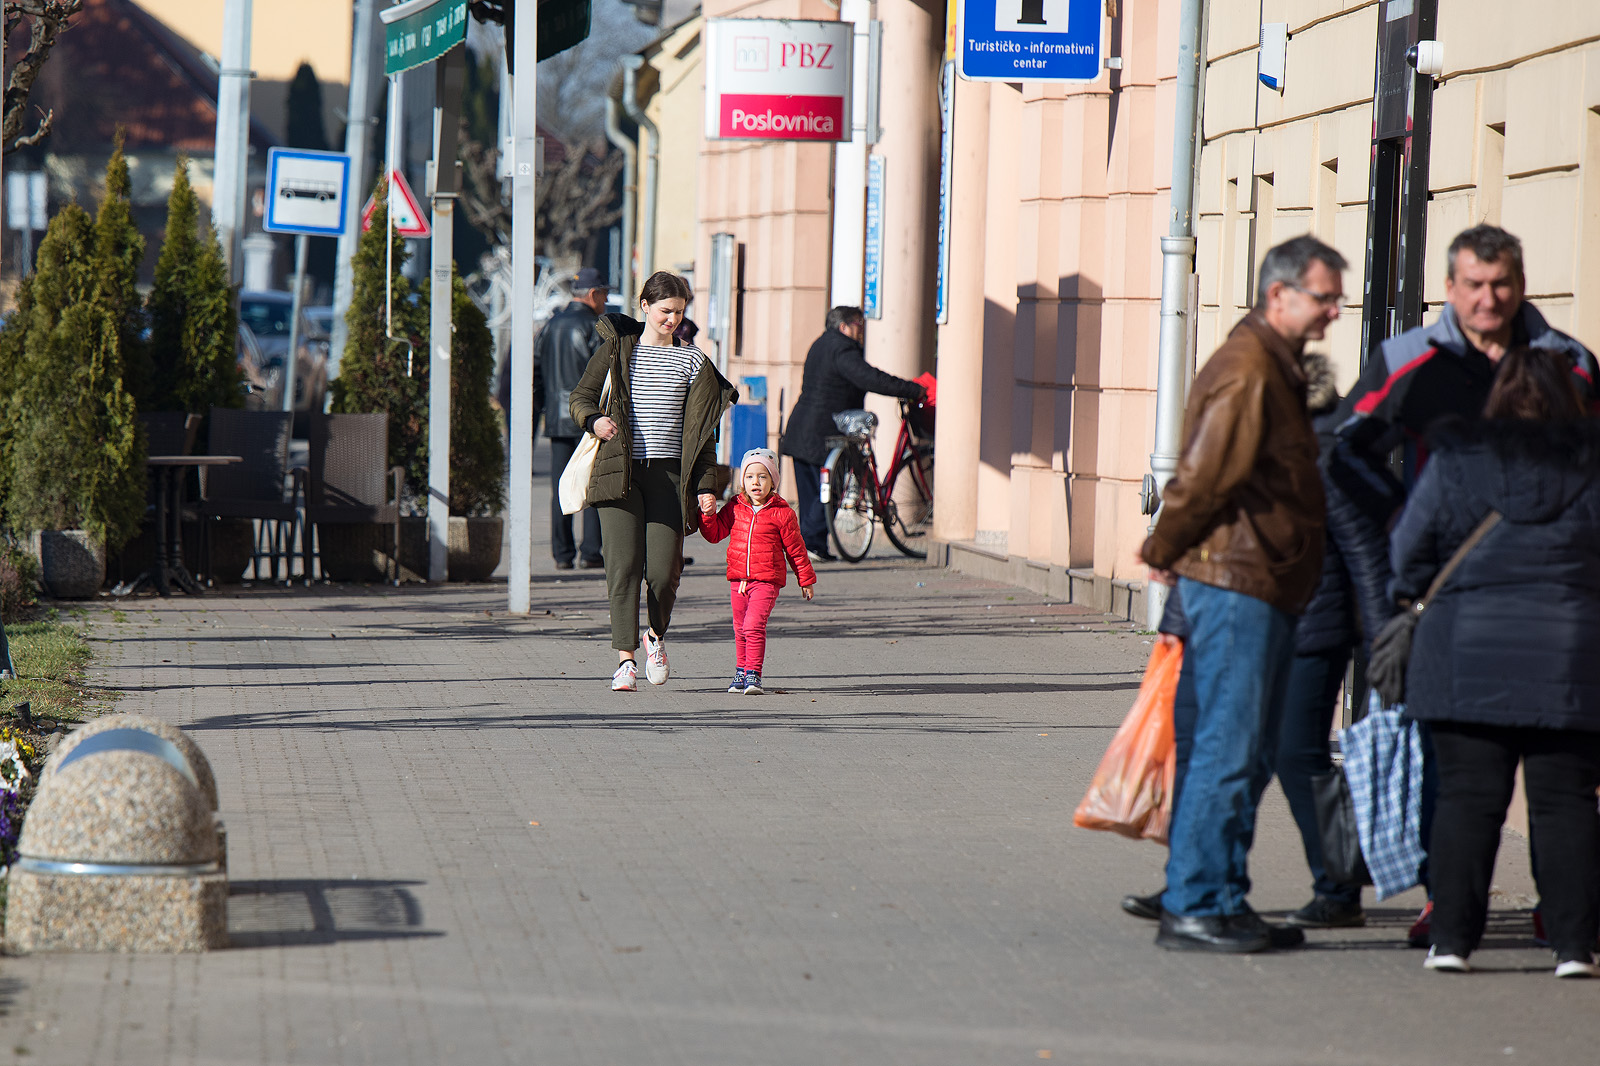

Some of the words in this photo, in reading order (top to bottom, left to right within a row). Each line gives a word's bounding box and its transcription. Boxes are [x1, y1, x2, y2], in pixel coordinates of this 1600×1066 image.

[969, 39, 1021, 53] Turističko
[781, 43, 834, 69] PBZ
[1013, 58, 1048, 69] centar
[732, 109, 834, 133] Poslovnica
